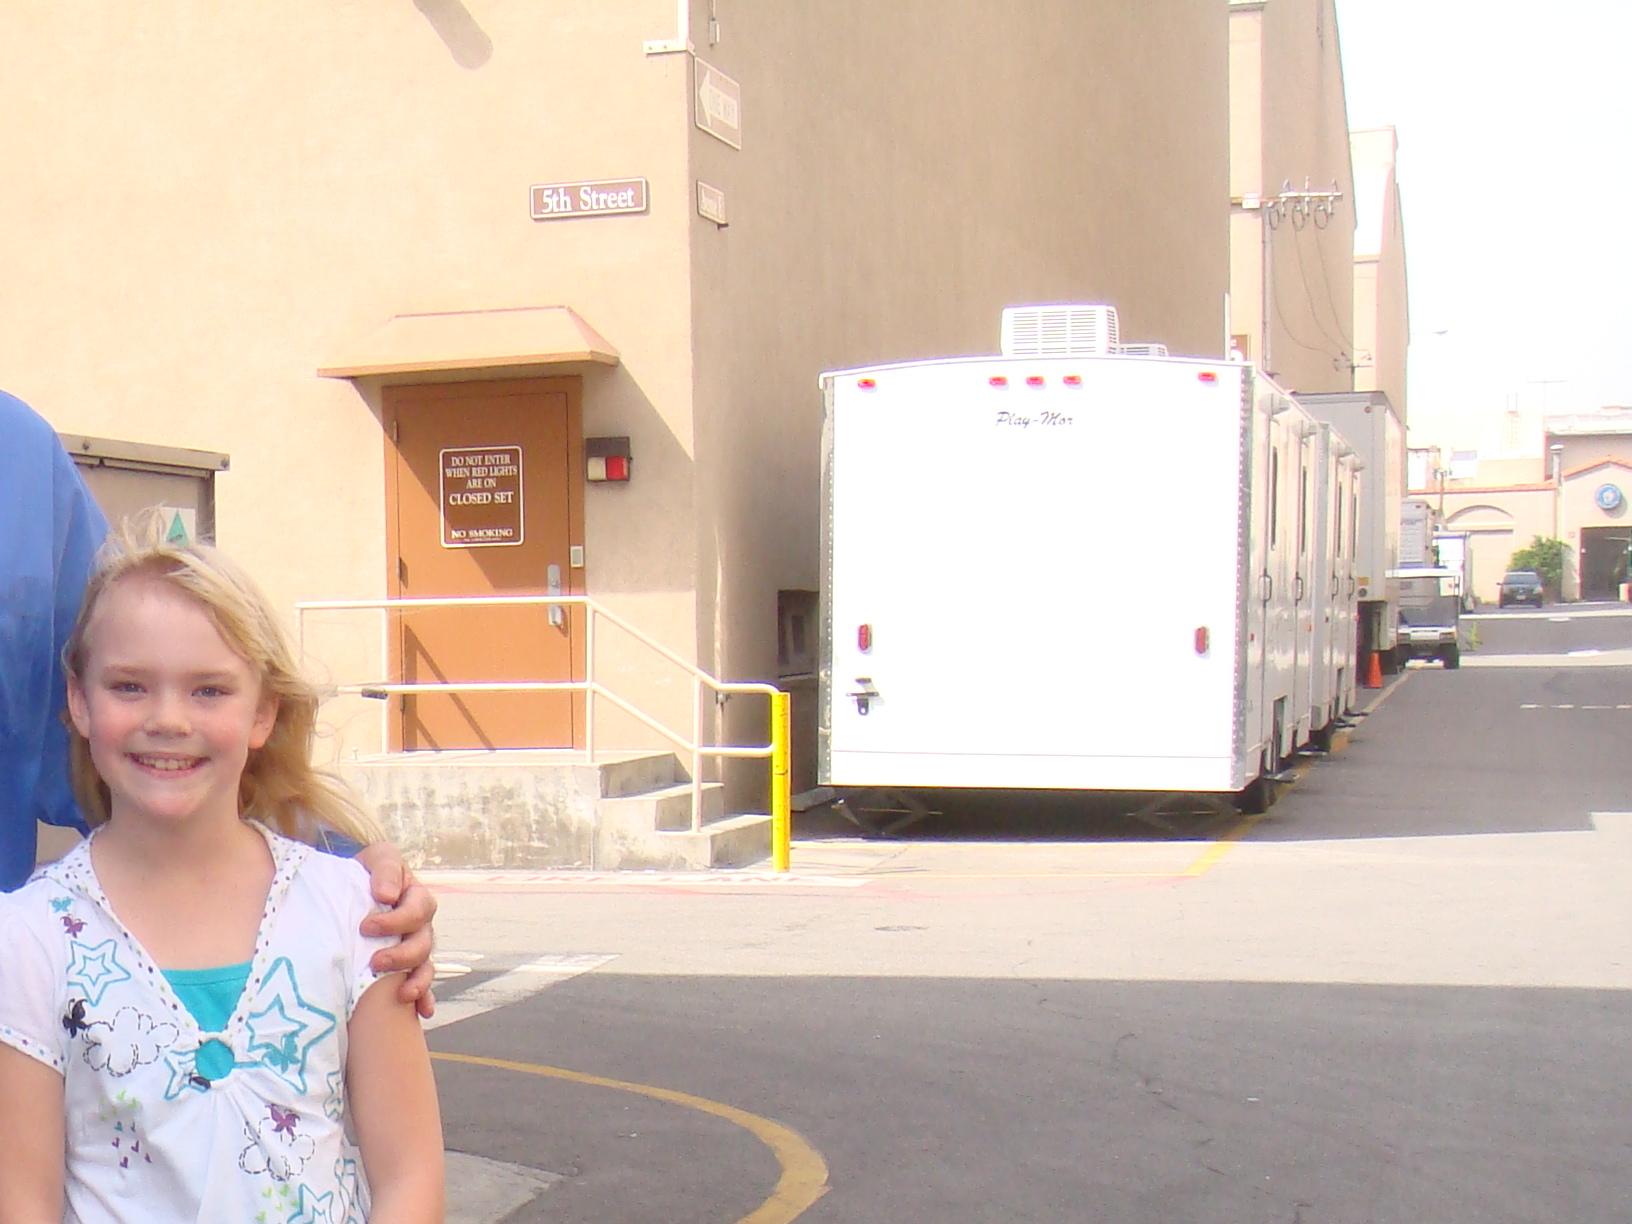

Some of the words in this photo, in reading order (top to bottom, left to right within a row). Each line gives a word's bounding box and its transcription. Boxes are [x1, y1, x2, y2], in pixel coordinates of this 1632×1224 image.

[542, 187, 572, 213] 5th
[579, 186, 635, 210] Street
[995, 411, 1073, 429] Play-Mor
[451, 456, 464, 467] DO
[465, 455, 483, 466] NOT
[484, 454, 511, 465] ENTER
[445, 467, 470, 478] WHEN
[471, 466, 488, 477] RED
[489, 465, 517, 476] LIGHTS
[466, 478, 483, 489] ARE
[484, 478, 497, 488] ON
[449, 492, 492, 505] CLOSED
[494, 491, 514, 504] SET
[451, 530, 466, 539] NO
[468, 528, 513, 538] SMOKING
